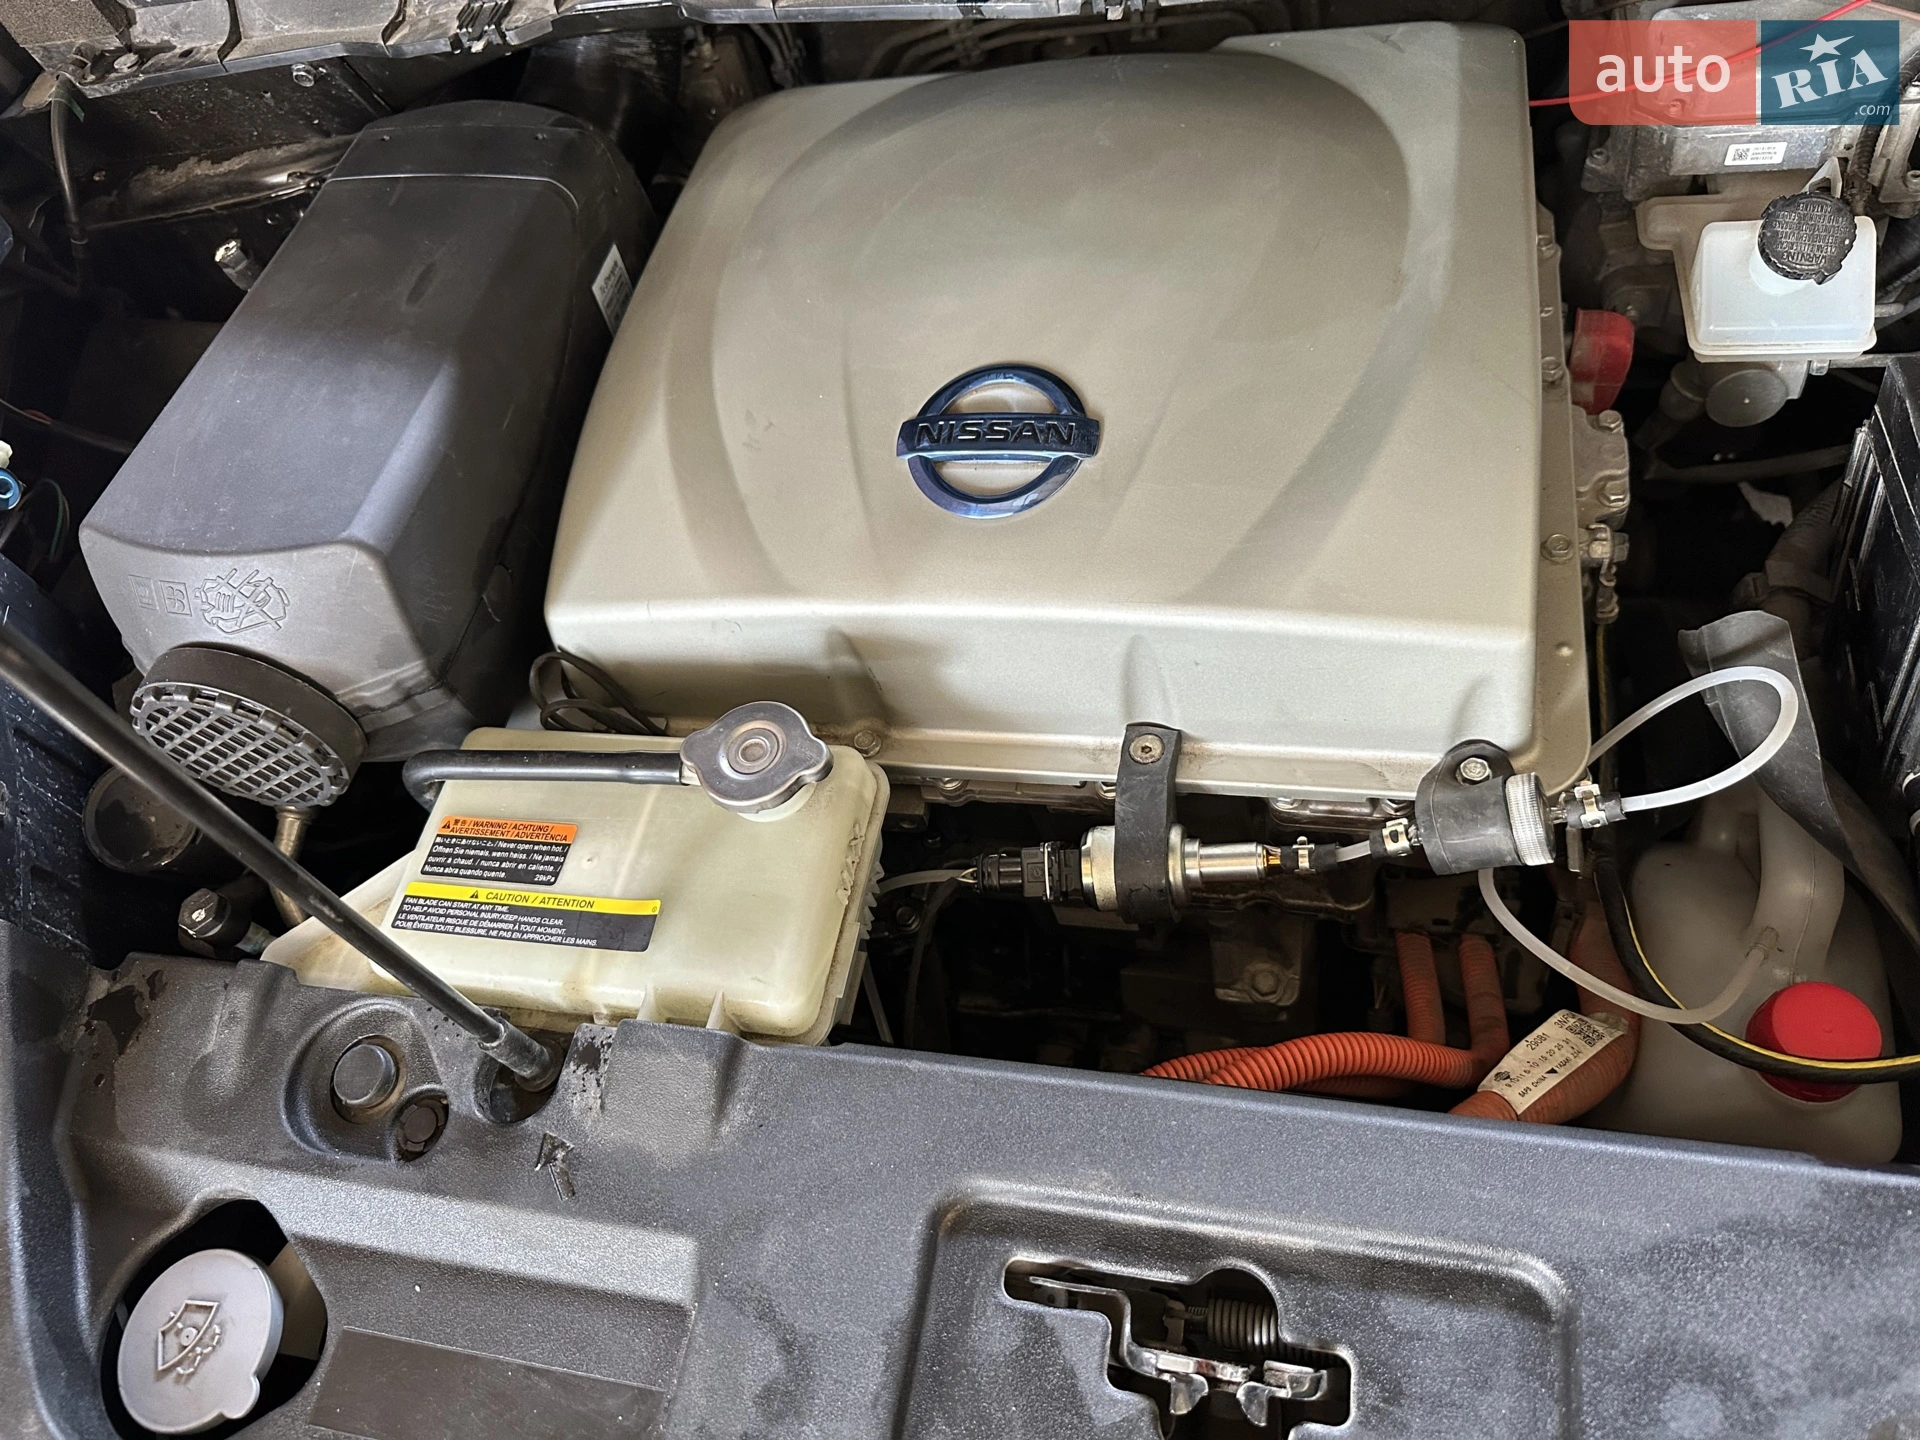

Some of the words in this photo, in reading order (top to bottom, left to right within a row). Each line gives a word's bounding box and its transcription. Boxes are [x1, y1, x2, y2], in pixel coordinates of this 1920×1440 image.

[916, 420, 1075, 447] NISSAN
[449, 826, 510, 837] AVERTISSEMENT
[473, 821, 507, 829] WARNING
[512, 823, 549, 833] ACHTUNG
[498, 841, 517, 849] Never
[517, 843, 534, 851] open
[465, 849, 491, 857] niemals,
[509, 851, 528, 859] heiss.
[533, 853, 542, 861] Ne
[542, 854, 564, 863] jamais
[445, 866, 458, 874] abra
[459, 867, 482, 876] quando
[453, 857, 474, 865] chaud.
[528, 863, 556, 872] caliente.
[486, 892, 529, 903] CAUTION
[539, 897, 595, 909] ATTENTION
[407, 914, 445, 923] VENTILATEUR
[445, 917, 469, 925] RISQUE
[479, 919, 513, 930] DÉMARRER
[520, 924, 537, 932] TOUT
[537, 926, 566, 935] MOMENT.
[447, 909, 479, 918] PERSONAL
[518, 915, 541, 923] HANDS
[541, 918, 563, 926] CLEAR.
[413, 921, 434, 930] ÉVITER
[434, 923, 453, 932] TOUTE
[454, 926, 487, 935] BLESSURE,
[498, 930, 512, 938] PAS
[522, 932, 563, 943] APPROCHER
[576, 938, 598, 946] MAINS.
[1546, 1049, 1555, 1057] 20
[1554, 1043, 1564, 1051] 25
